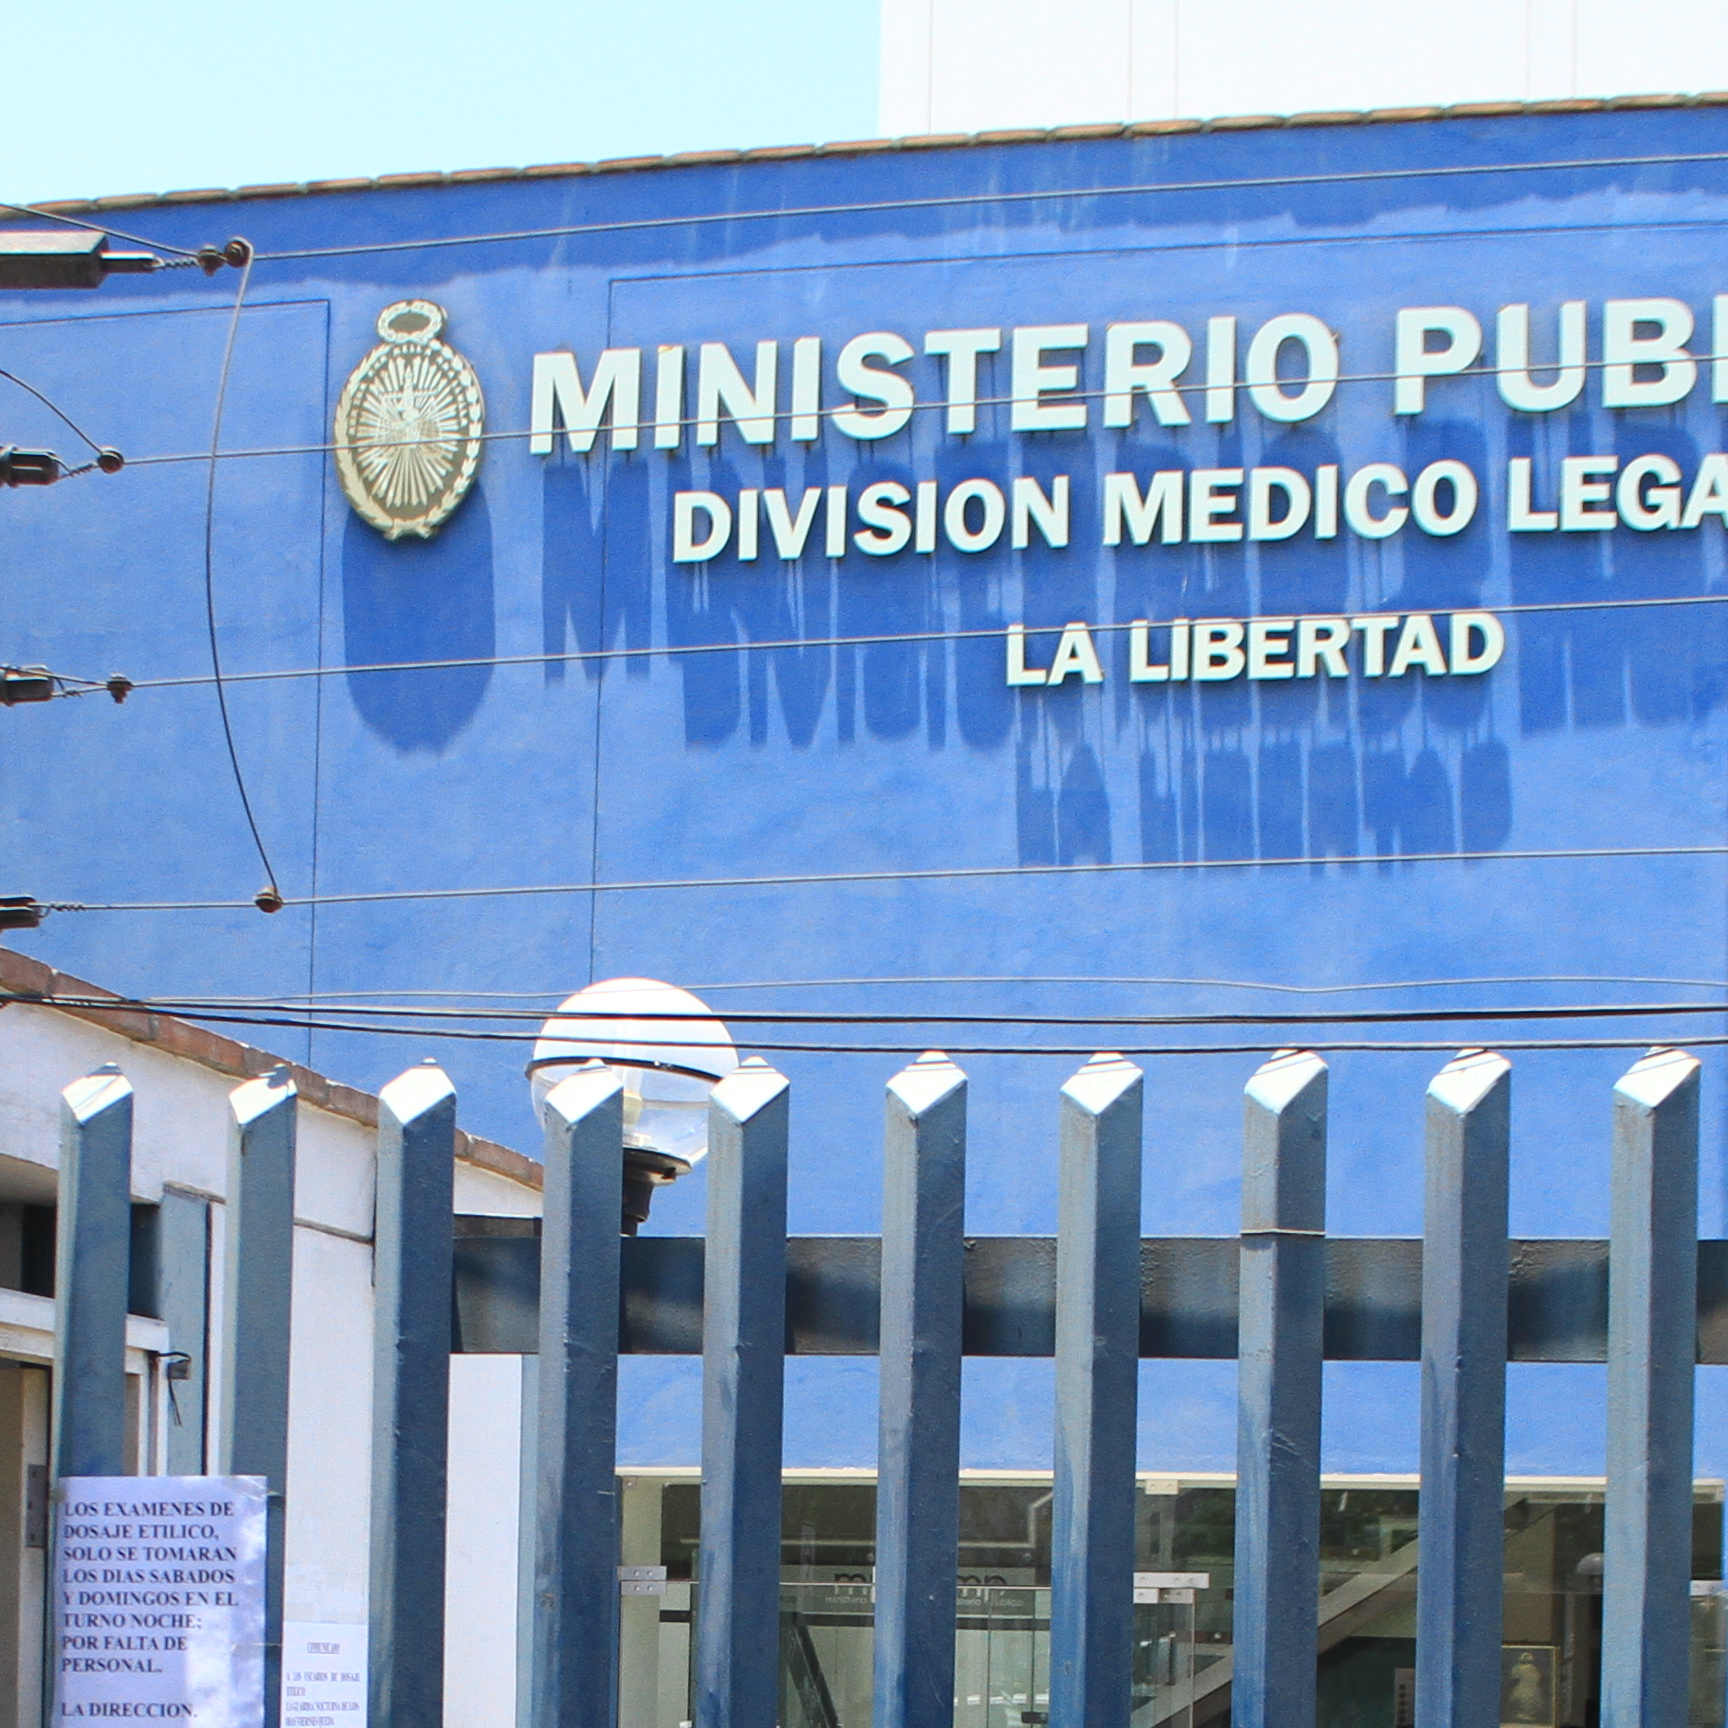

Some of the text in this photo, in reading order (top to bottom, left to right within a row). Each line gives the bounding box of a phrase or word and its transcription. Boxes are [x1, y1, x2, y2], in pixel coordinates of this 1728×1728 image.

[529, 314, 1340, 455] MINISTERIO
[673, 475, 1070, 562] DIVISION
[1103, 459, 1476, 546] MEDICO
[1006, 611, 1505, 687] LA LIBERTAD
[64, 1502, 234, 1517] LOS EXAMENES DE
[64, 1525, 220, 1541] DOSAJE ETILICO,
[64, 1547, 237, 1561] SOLO SE TOMARAN
[63, 1569, 235, 1584] LOS DIAS SABADOS
[63, 1592, 238, 1606] Y DOMINGOS EN EL
[63, 1614, 124, 1628] TURNO
[63, 1636, 187, 1651] POR FALTA DE
[62, 1658, 163, 1673] PERSONAL.
[62, 1703, 198, 1718] LA DIRECCION.
